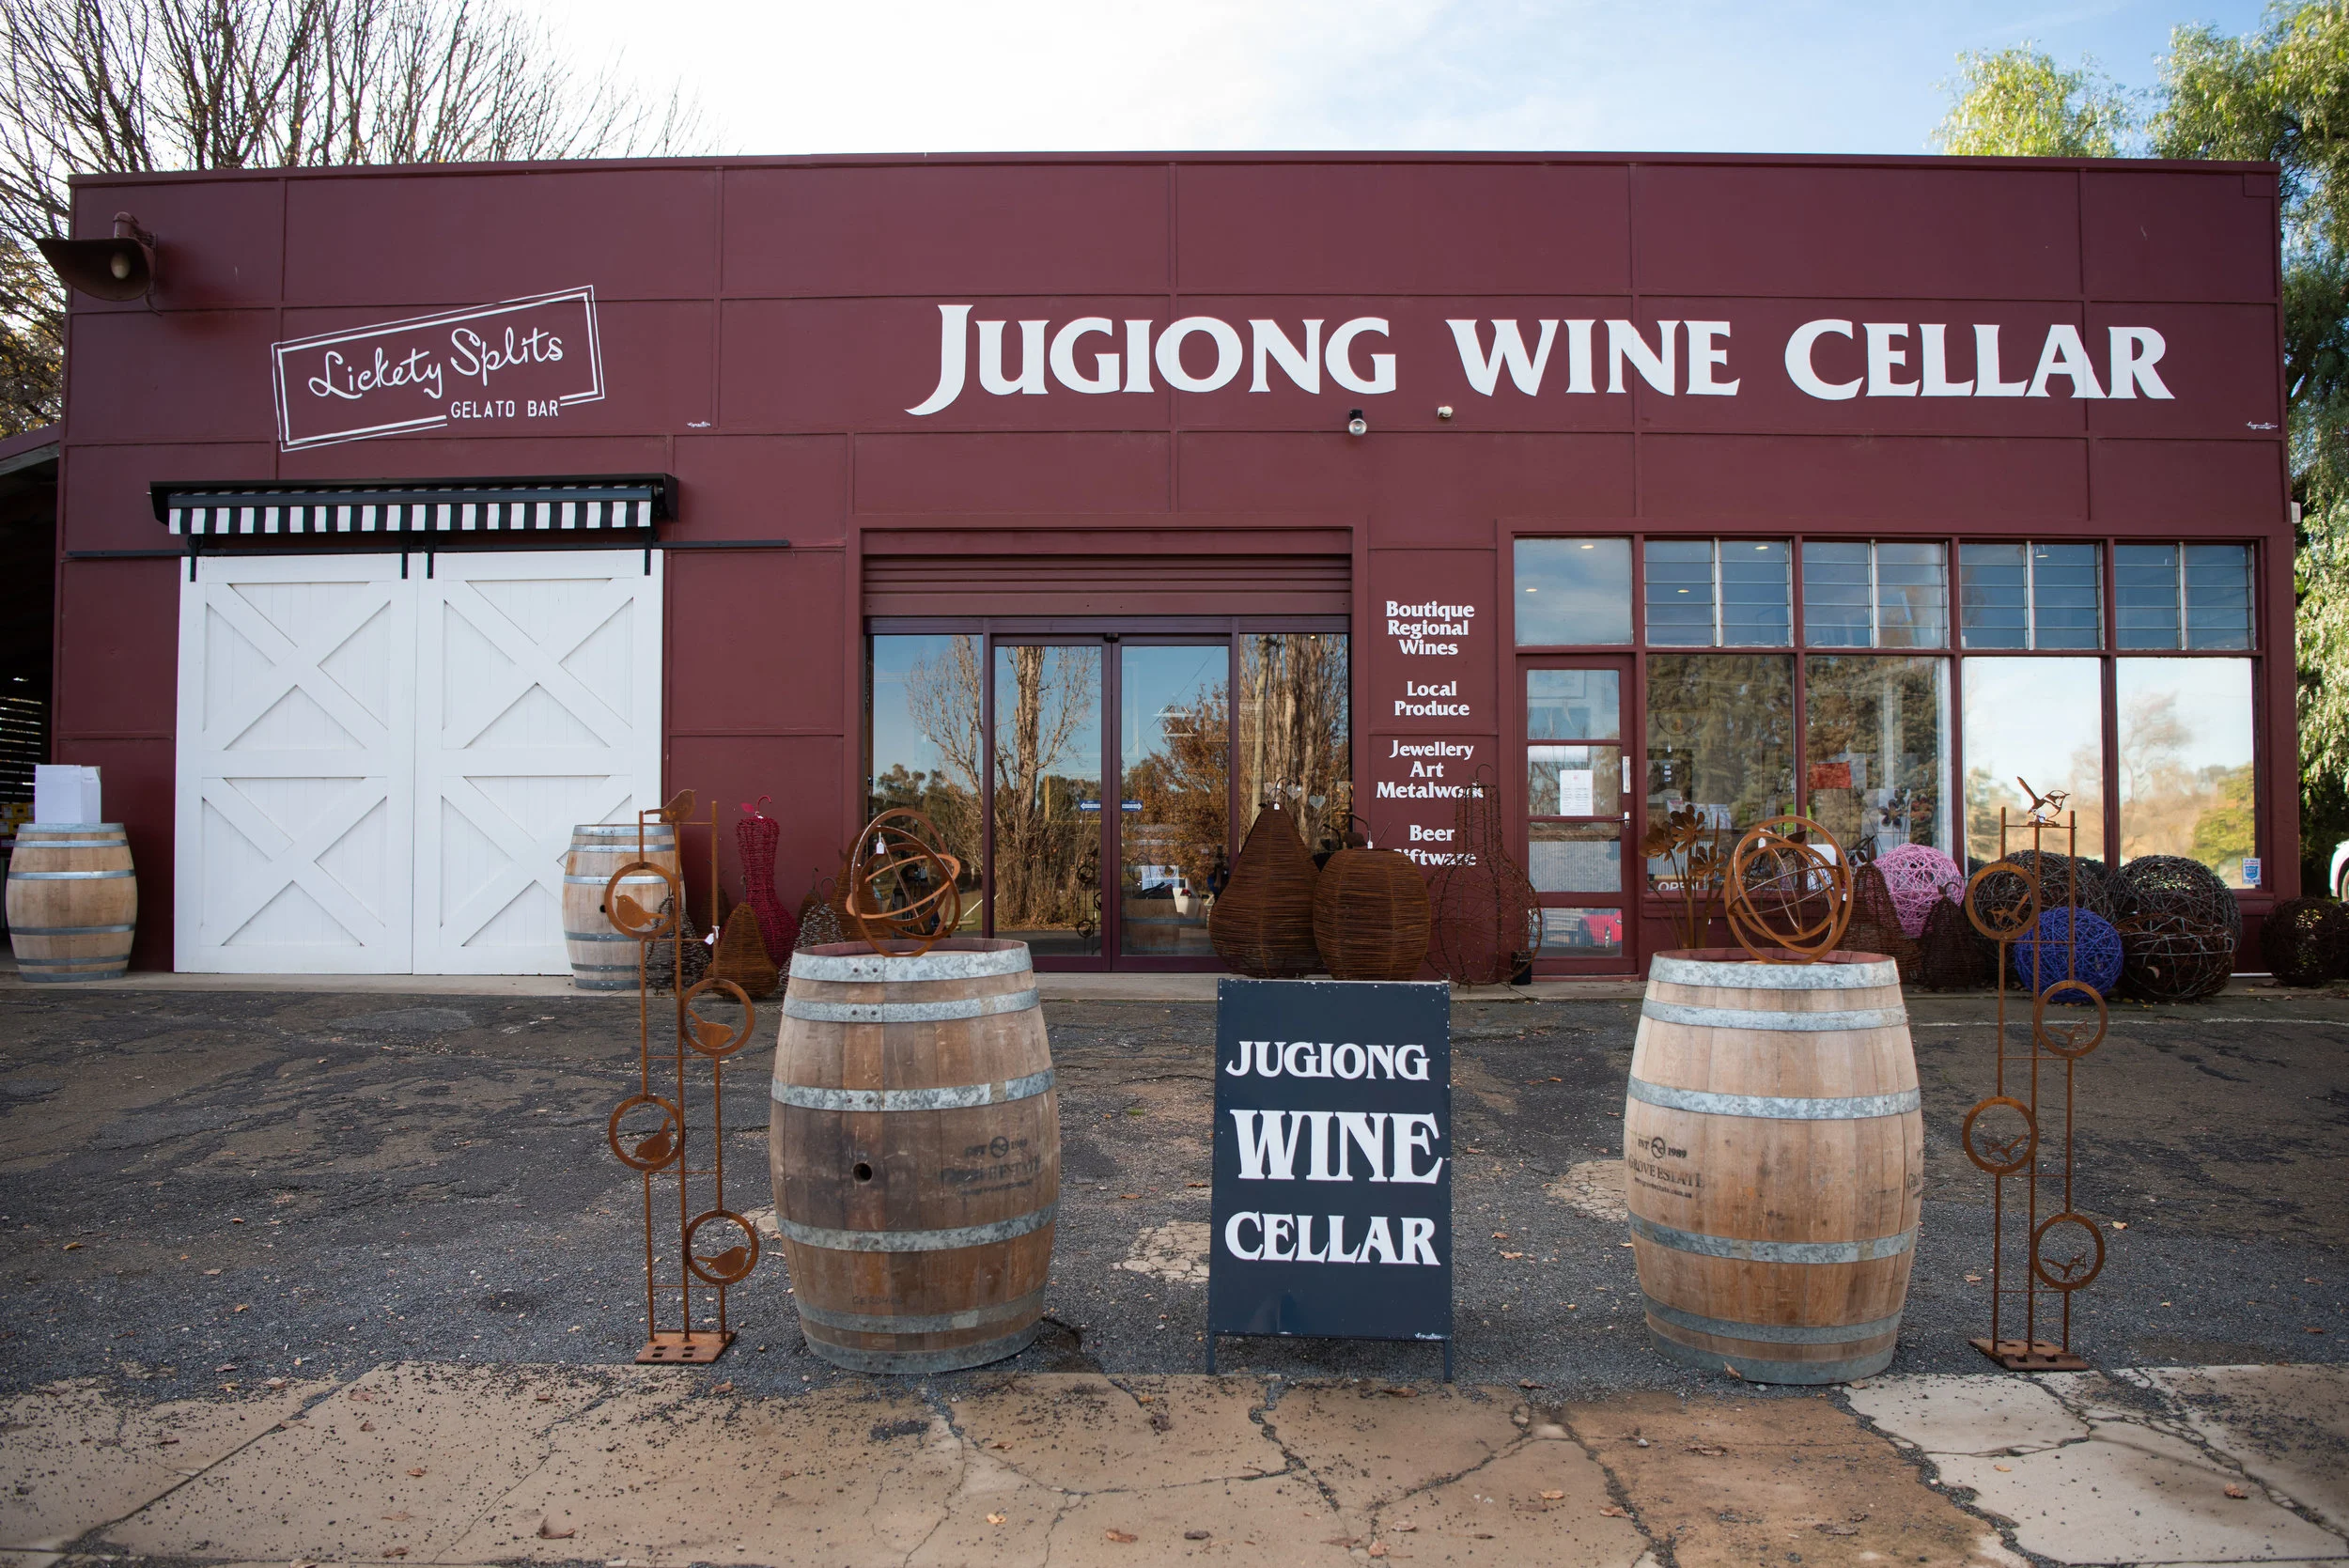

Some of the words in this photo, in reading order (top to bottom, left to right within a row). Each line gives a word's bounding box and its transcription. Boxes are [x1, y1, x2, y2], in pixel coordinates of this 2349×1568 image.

[308, 347, 443, 398] Lickety
[450, 326, 564, 386] Splits
[905, 304, 1396, 415] JUGIONG
[1445, 318, 1740, 396] WINE
[1784, 318, 2176, 401] CELLAR
[451, 400, 515, 419] GELATO
[527, 399, 559, 418] BAR
[1386, 600, 1475, 621] Boutique
[1387, 619, 1470, 640] Regional
[1398, 639, 1459, 656] Wines
[1407, 680, 1457, 697] Local
[1394, 700, 1470, 716] Produce
[1389, 739, 1474, 760] Jewellery
[1409, 761, 1444, 778] Art
[1376, 781, 1484, 799] Metalwork
[1409, 824, 1455, 842] Beer
[1393, 848, 1477, 866] ftware
[1224, 1040, 1431, 1081] JUGIONG
[1229, 1109, 1443, 1185] WINE
[1638, 1139, 1649, 1150] EST
[1668, 1146, 1688, 1159] 1989
[1628, 1154, 1656, 1178] GROVE
[1224, 1211, 1441, 1266] CELLAR
